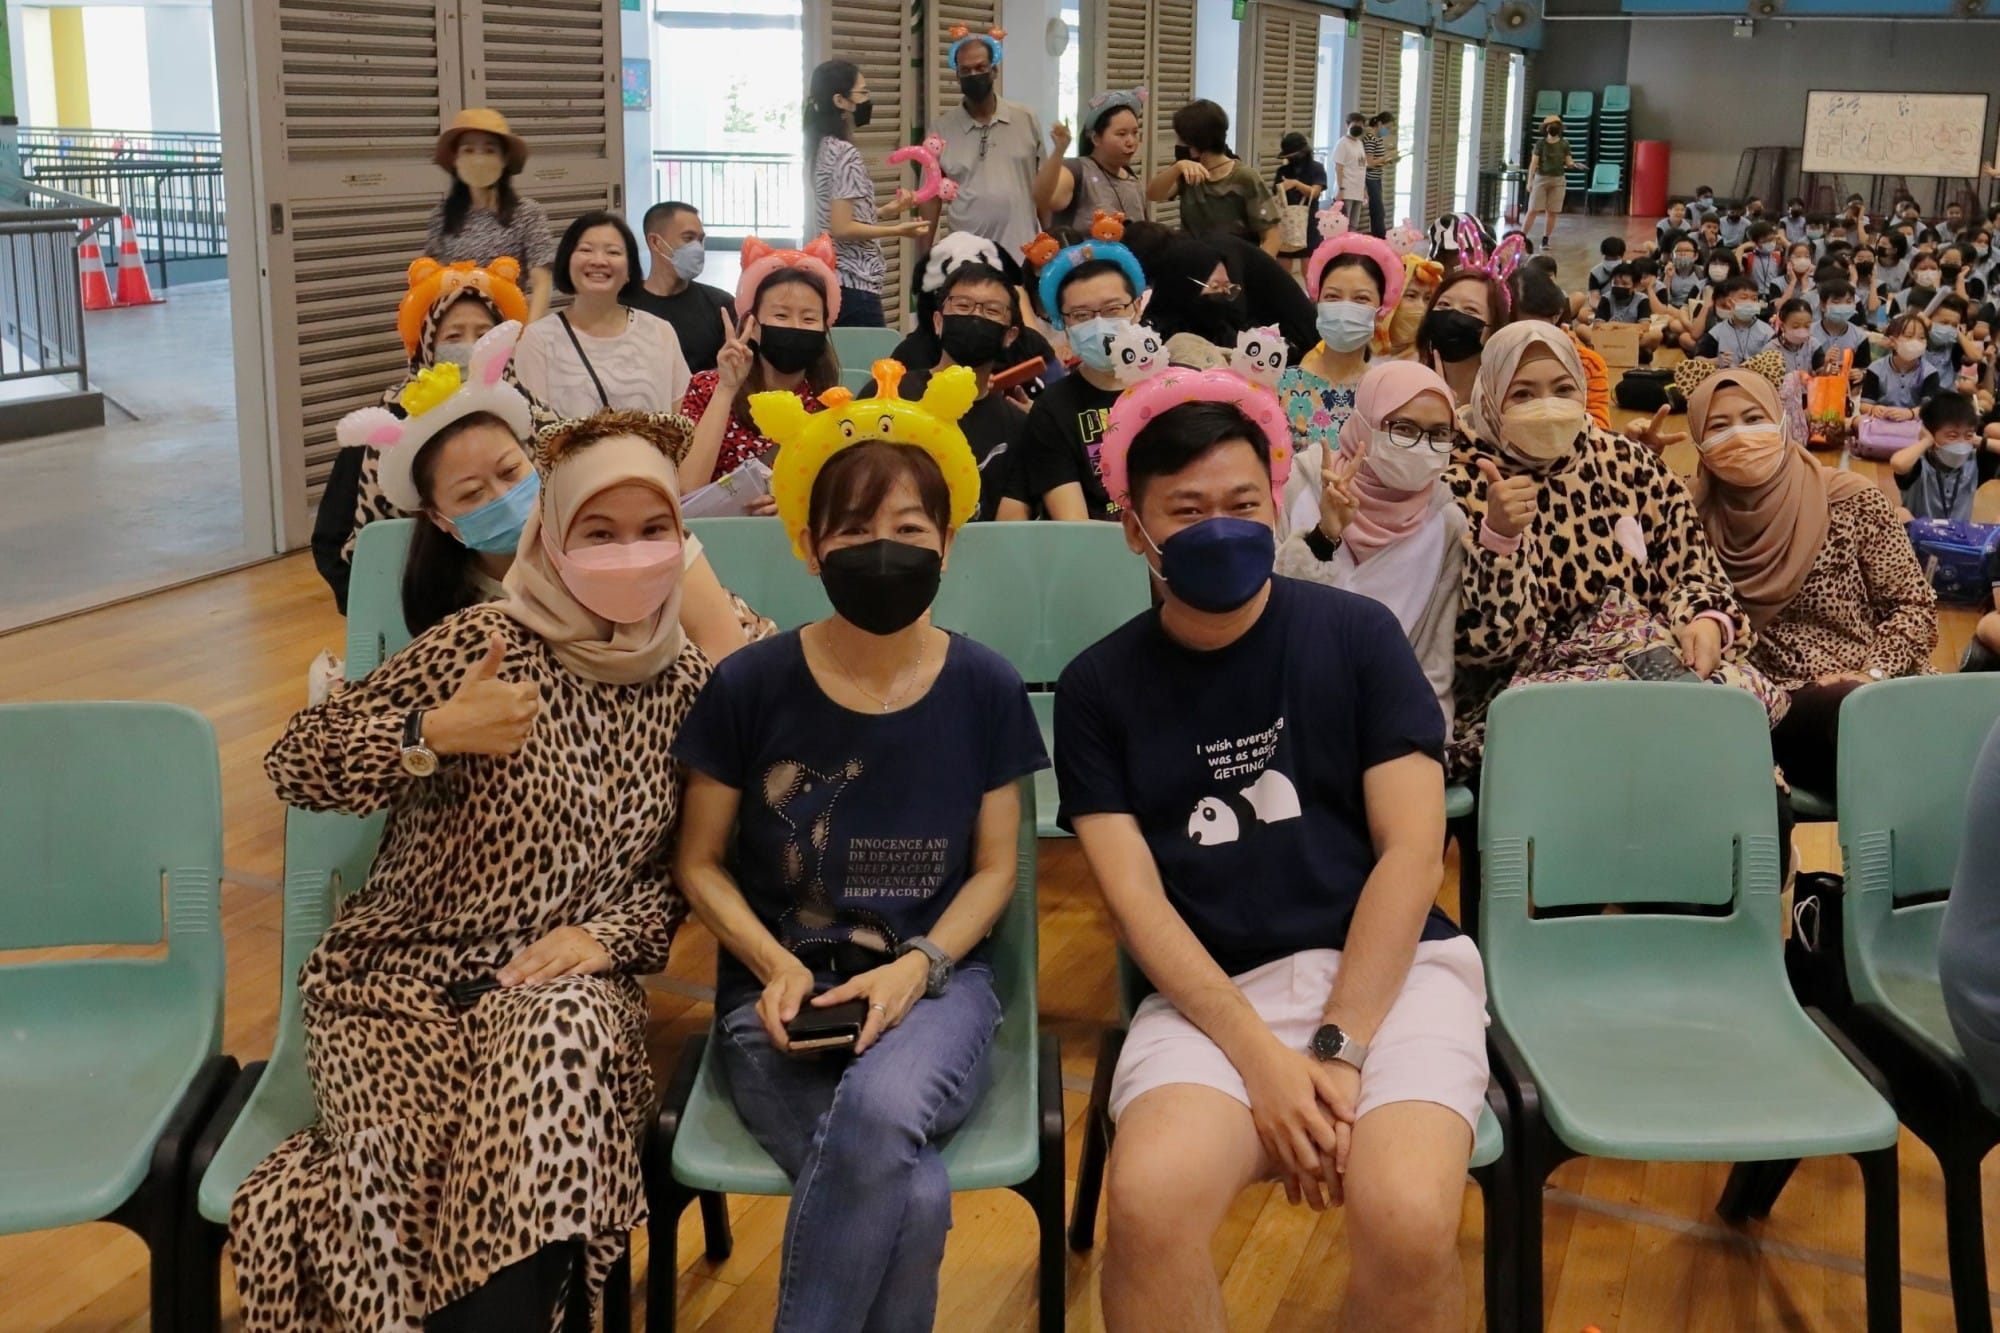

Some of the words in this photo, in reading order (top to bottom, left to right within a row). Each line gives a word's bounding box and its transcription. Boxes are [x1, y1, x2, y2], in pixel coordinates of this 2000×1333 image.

[1196, 744, 1201, 755] I
[1205, 738, 1233, 753] wish
[1208, 756, 1232, 767] was
[1235, 751, 1248, 762] as
[1213, 758, 1265, 780] GETTING
[849, 838, 923, 850] INNOCENCE
[925, 838, 949, 849] AND
[912, 852, 929, 862] OF
[846, 875, 917, 887] INNOCENCE
